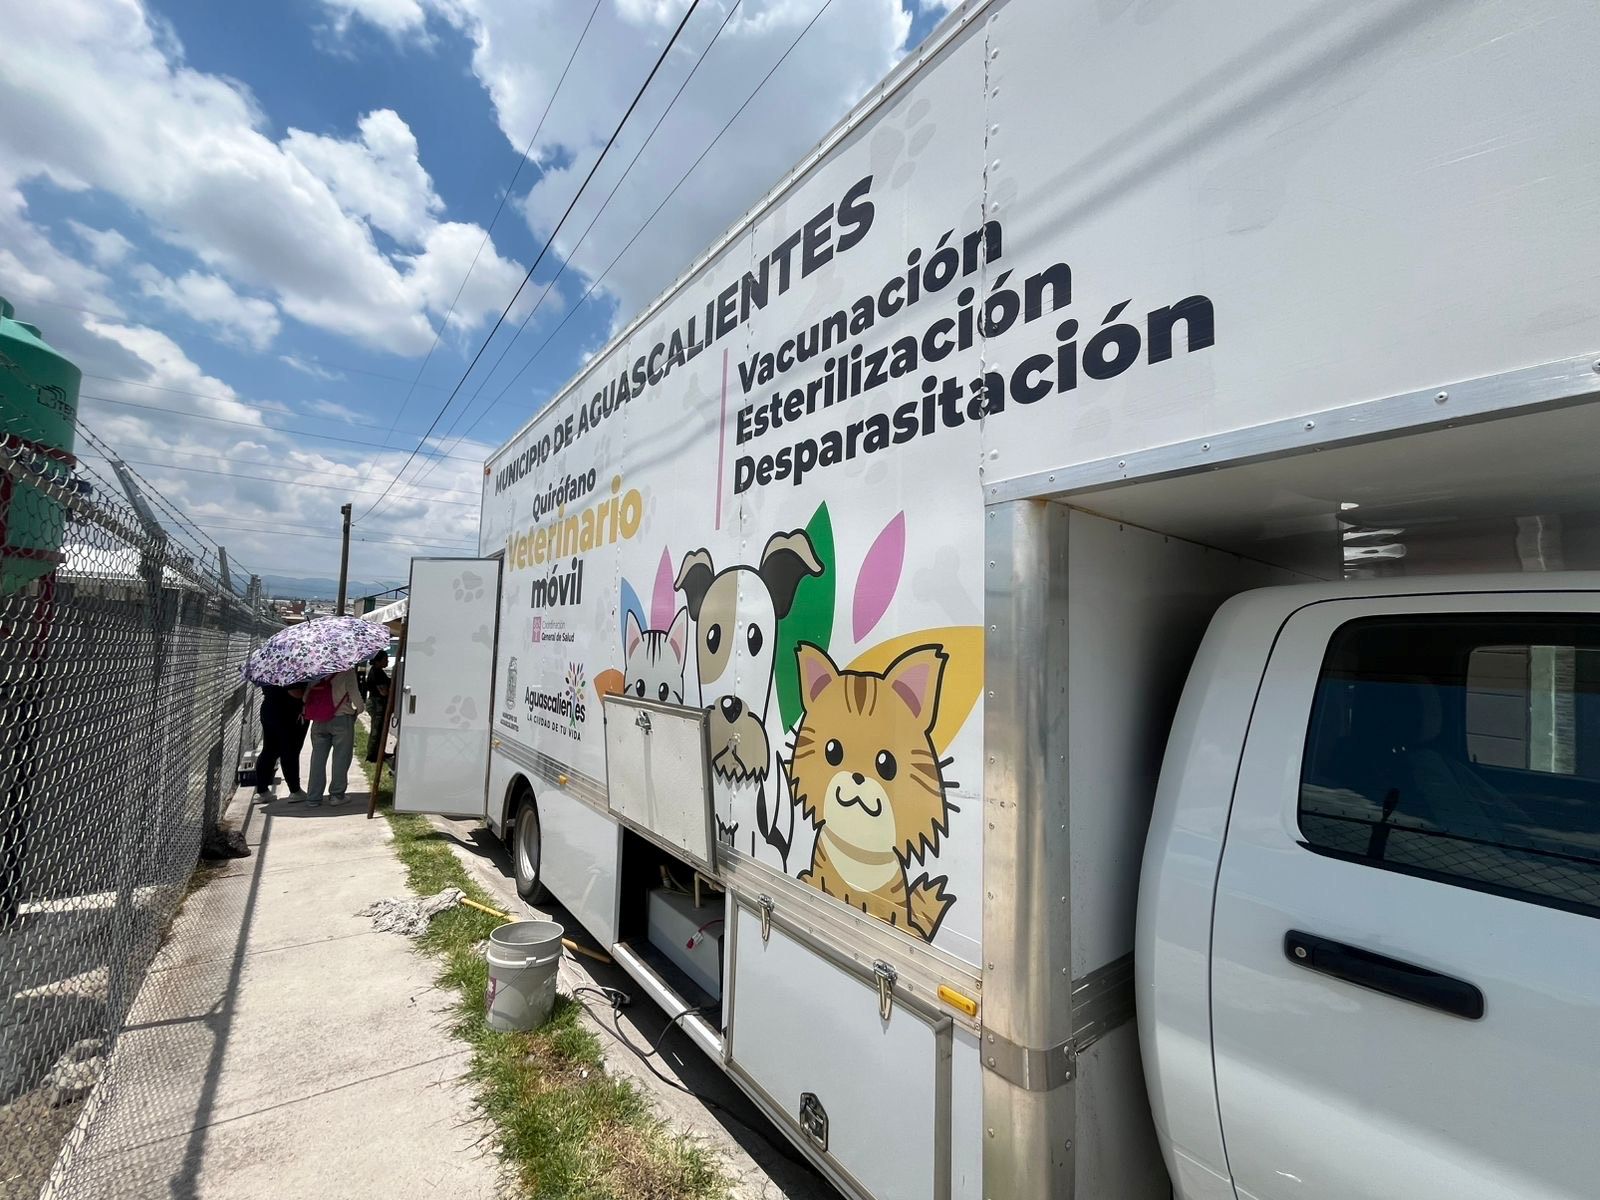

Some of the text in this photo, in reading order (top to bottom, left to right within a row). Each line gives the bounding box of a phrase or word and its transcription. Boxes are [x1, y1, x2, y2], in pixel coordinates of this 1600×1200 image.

[495, 175, 875, 496] MUNICIPIO DE AGUASCALIENTES
[736, 262, 1072, 446] Esterilización
[738, 219, 1003, 394] Vacunación
[734, 295, 1215, 494] Desparasitación
[508, 475, 642, 572] Veterinario
[532, 468, 597, 522] Quirófano
[531, 557, 583, 608] móvil
[562, 632, 575, 642] Salud
[527, 713, 532, 721] LA
[533, 715, 550, 728] CIUDAD
[551, 722, 558, 732] DE
[560, 725, 567, 735] TU
[568, 728, 581, 741] VIDA
